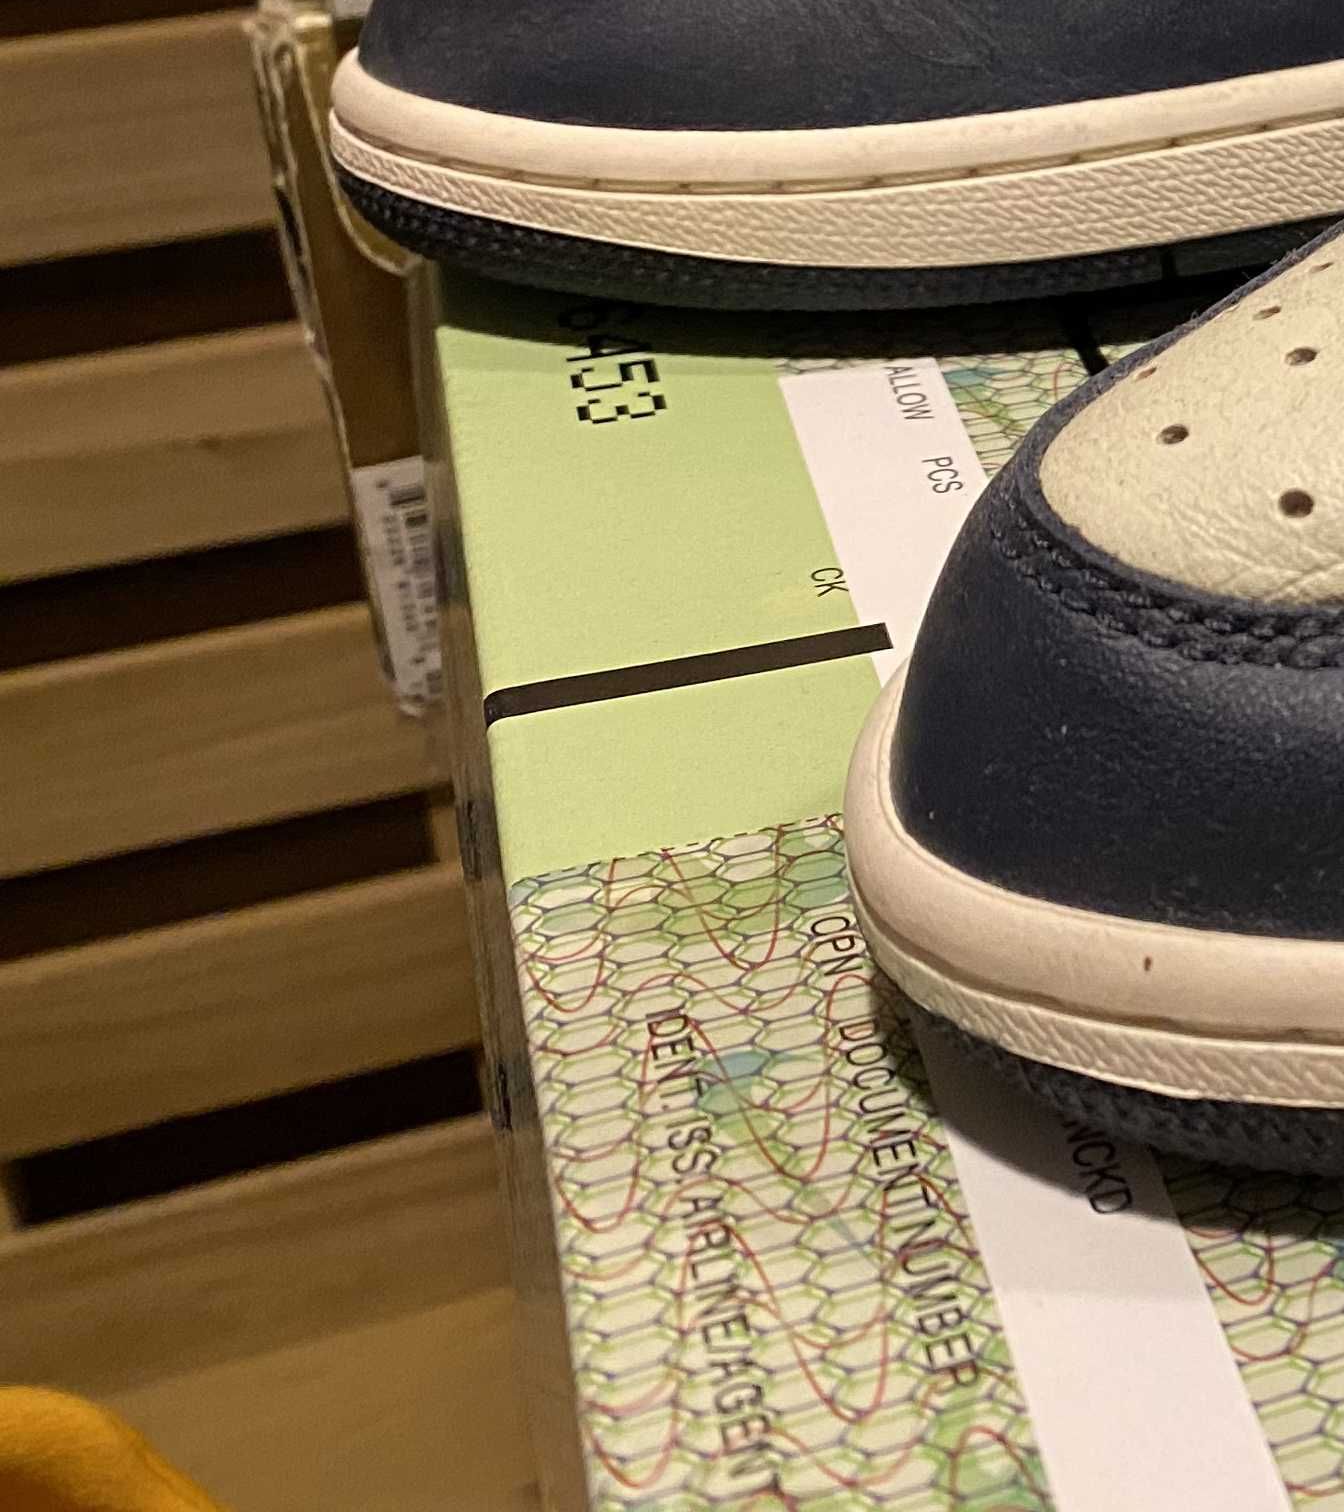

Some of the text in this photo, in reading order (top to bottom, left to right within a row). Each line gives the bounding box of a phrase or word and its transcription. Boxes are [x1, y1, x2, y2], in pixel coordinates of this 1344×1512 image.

[884, 365, 964, 495] ALLOW PCS
[810, 567, 849, 598] CK
[838, 1021, 931, 1211] DOCUMENT
[892, 1219, 979, 1394] NUMBER
